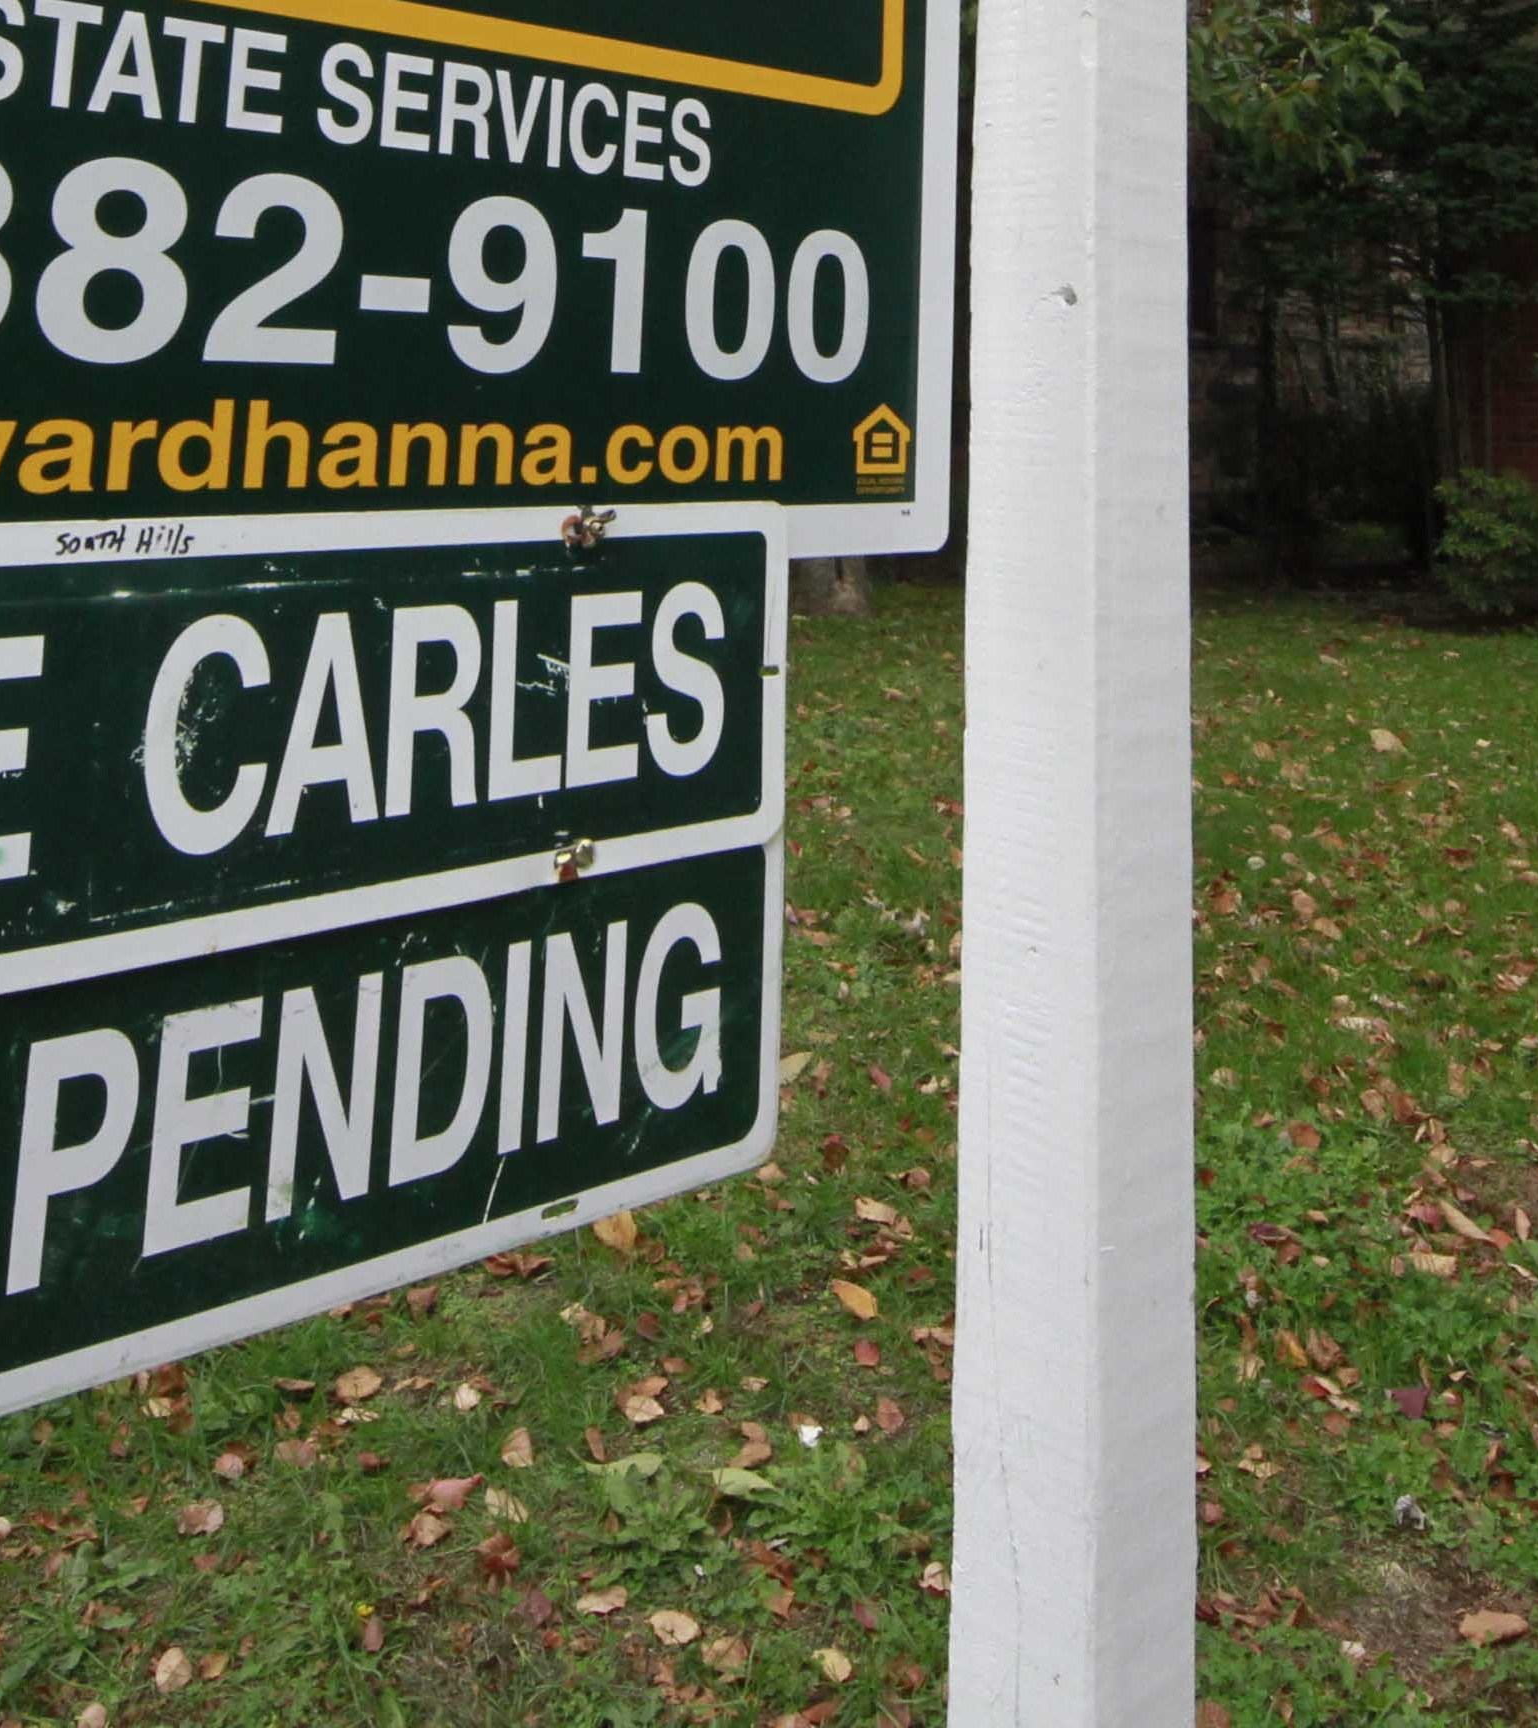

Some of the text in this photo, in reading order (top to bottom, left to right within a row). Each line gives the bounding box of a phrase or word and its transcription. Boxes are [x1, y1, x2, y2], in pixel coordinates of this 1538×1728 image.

[317, 42, 711, 187] SERVICES
[141, 581, 725, 856] CARLES
[6, 902, 723, 1295] PENDING
